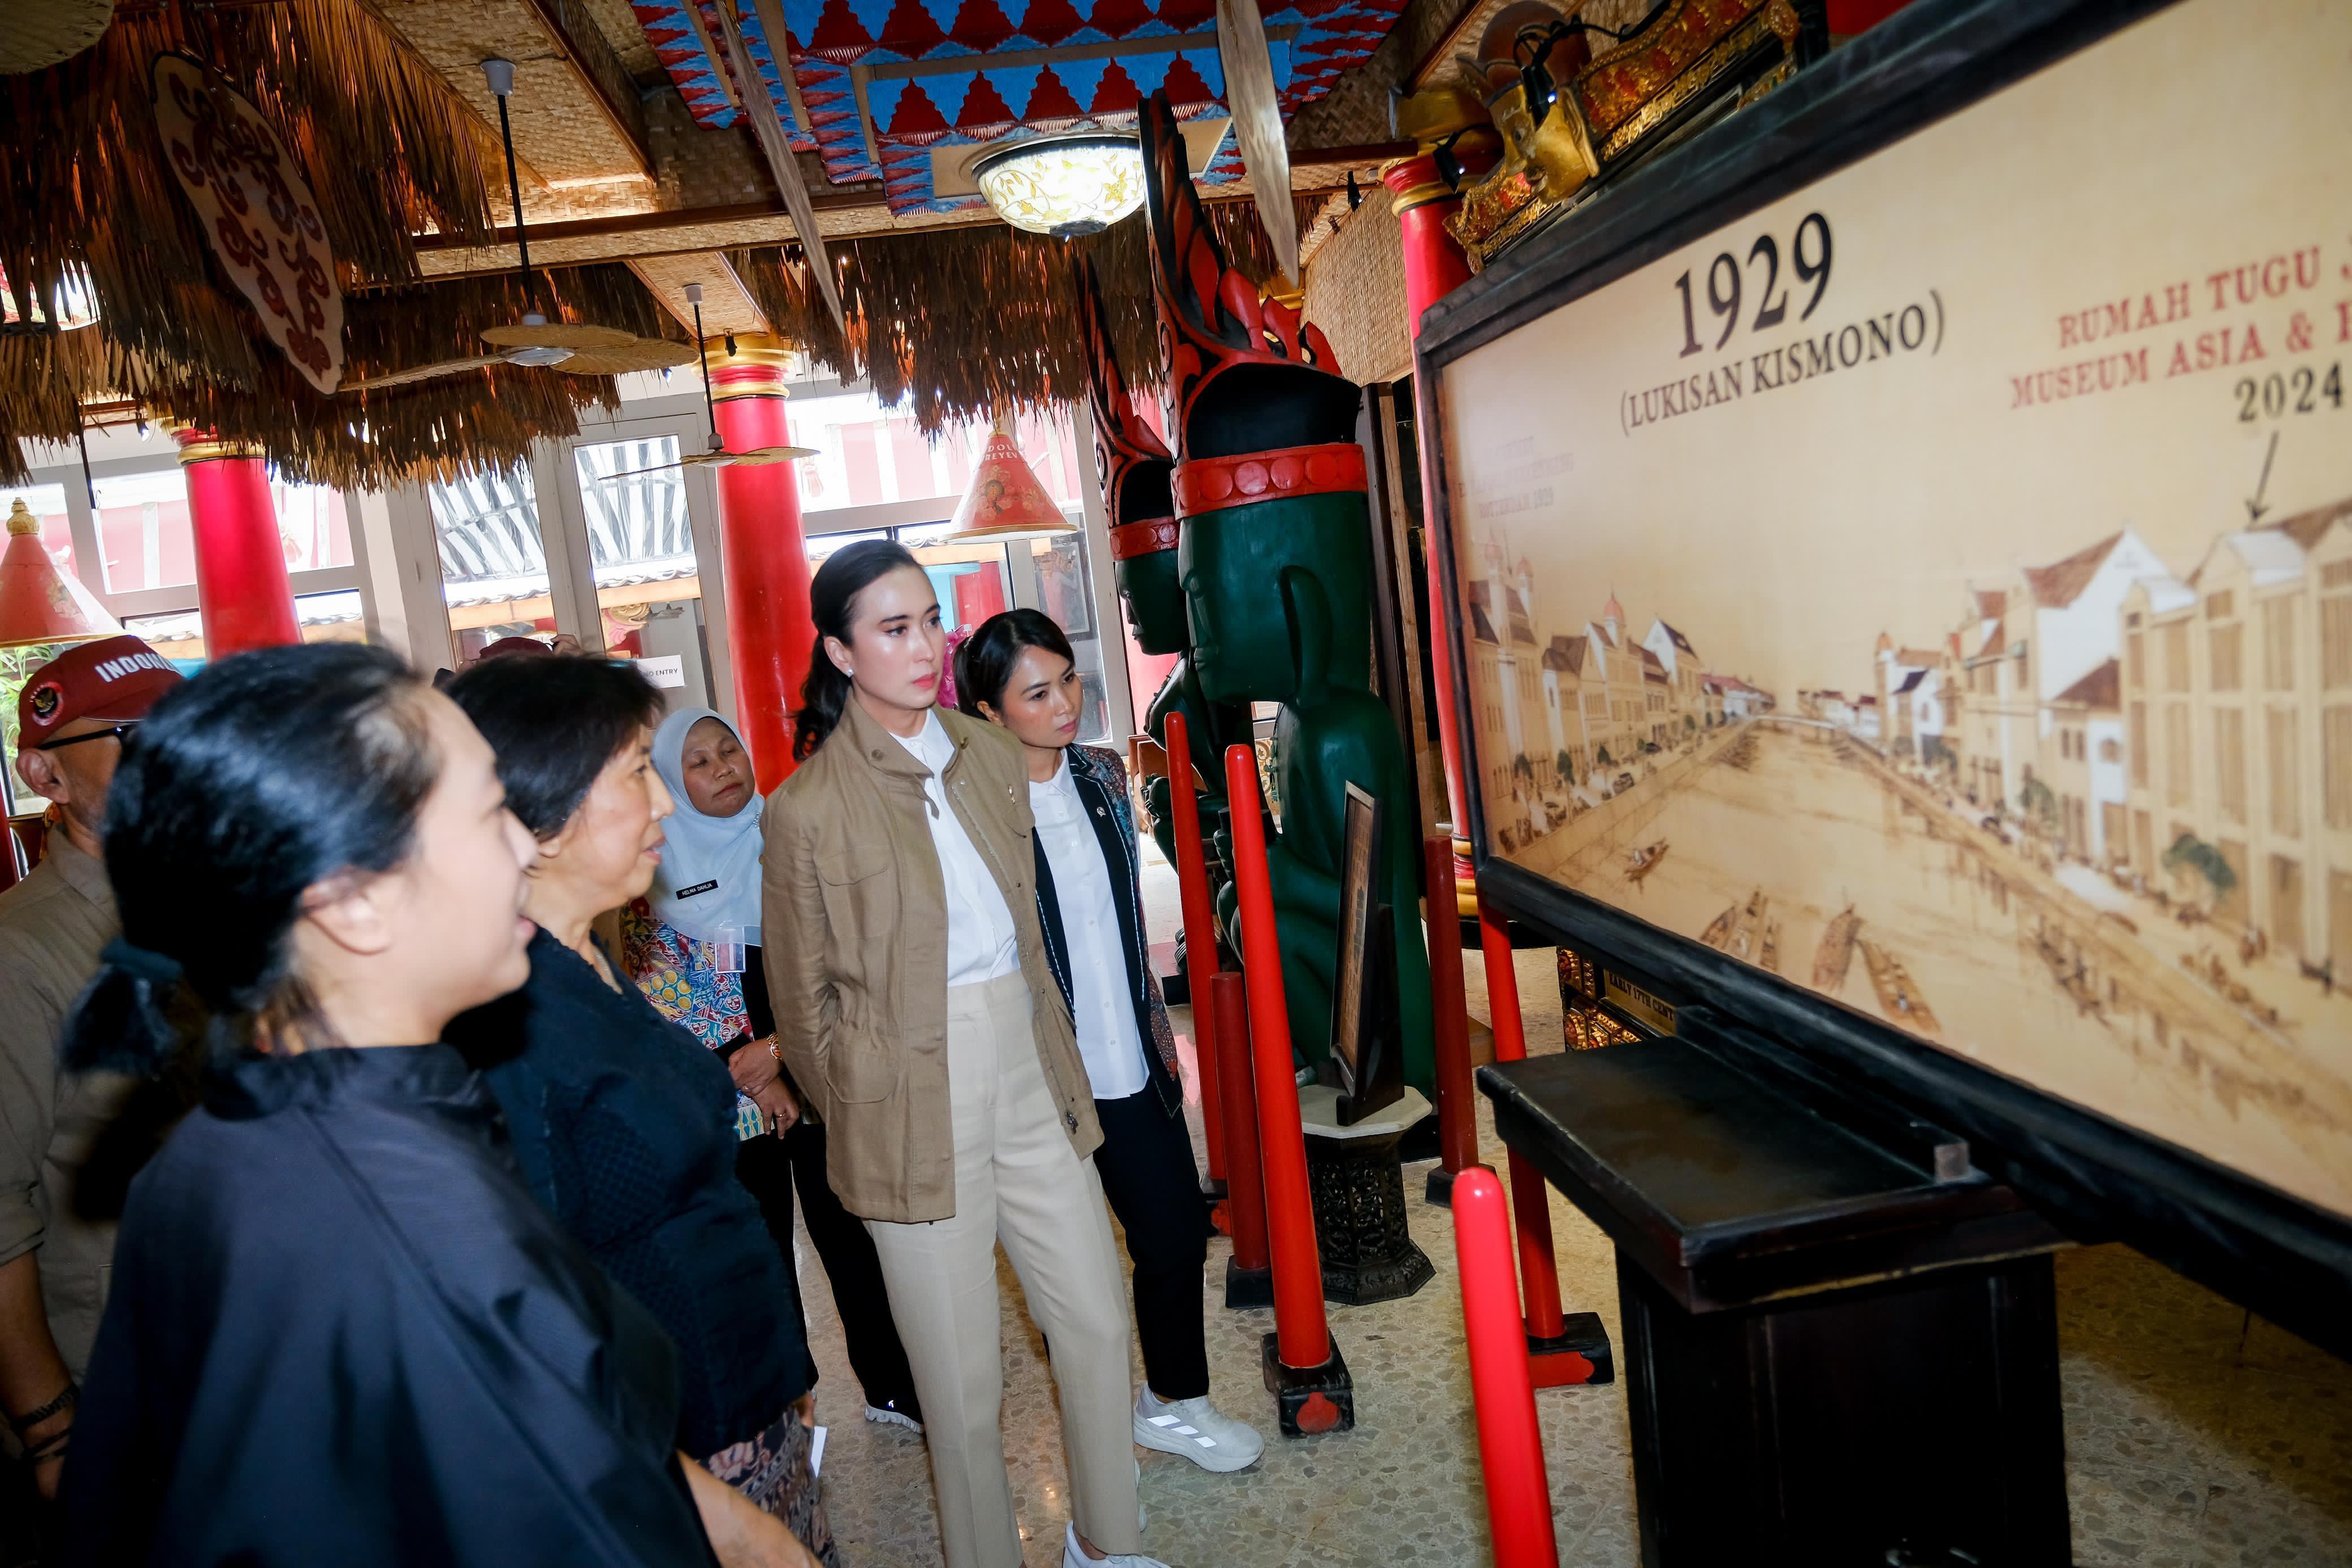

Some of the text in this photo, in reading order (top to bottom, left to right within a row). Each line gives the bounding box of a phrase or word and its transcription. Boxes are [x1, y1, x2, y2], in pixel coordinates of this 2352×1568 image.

[1675, 212, 1833, 359] 1929
[2058, 280, 2191, 350] RUMAH
[2207, 245, 2321, 311] TUGU
[1620, 288, 1945, 438] (LUKISAN KISMONO)
[2011, 345, 2149, 410] MUSEUM
[2166, 322, 2267, 378] ASIA
[2285, 311, 2313, 354] &
[2233, 359, 2345, 423] 2024
[1633, 987, 1651, 1008] 17TH
